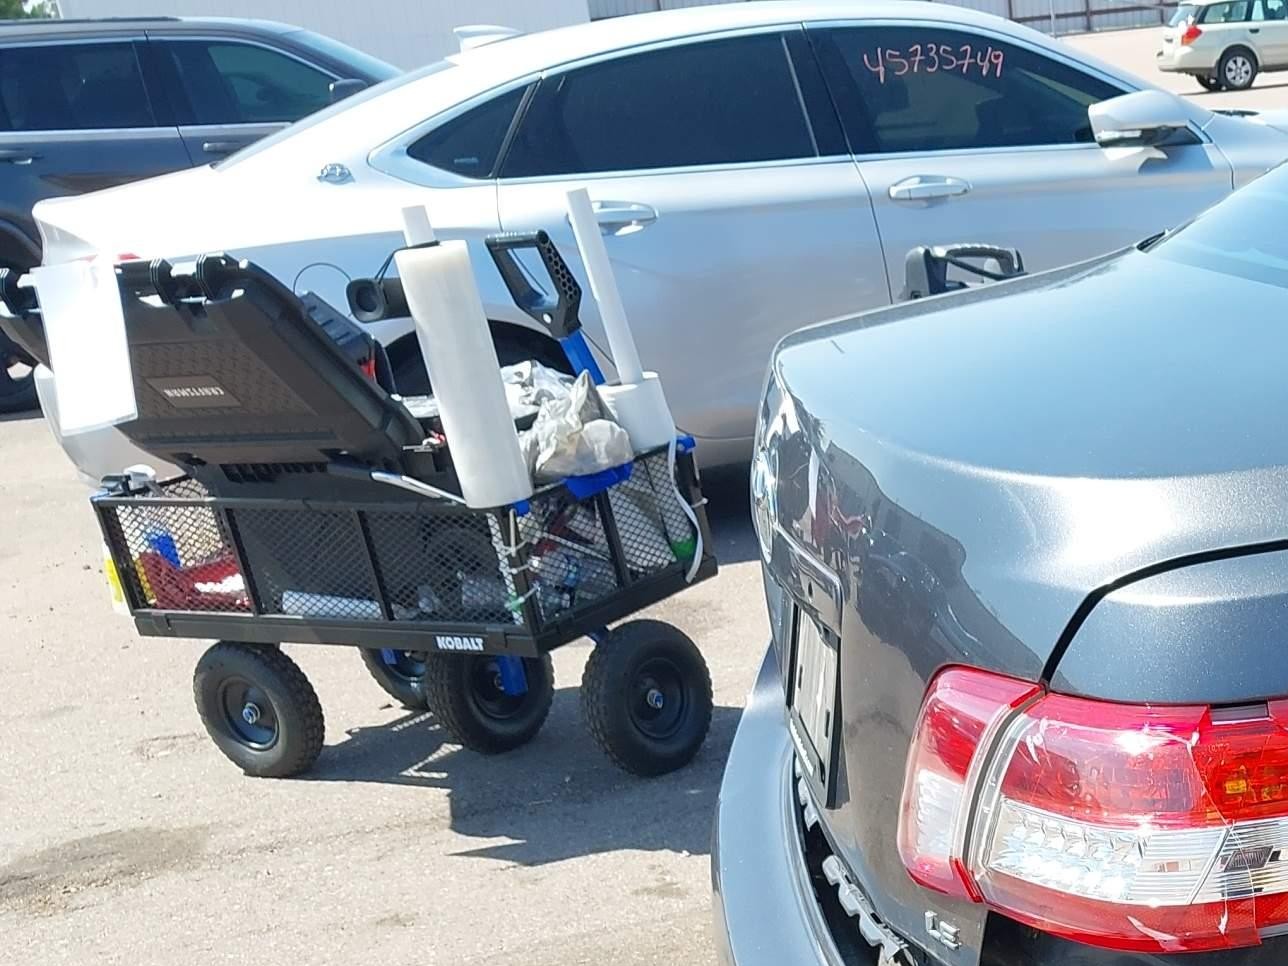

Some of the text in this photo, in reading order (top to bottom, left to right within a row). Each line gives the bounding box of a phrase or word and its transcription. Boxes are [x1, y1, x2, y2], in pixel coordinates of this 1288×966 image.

[863, 43, 1004, 84] 45735749
[435, 635, 484, 651] KOBALT
[925, 910, 962, 951] LE
